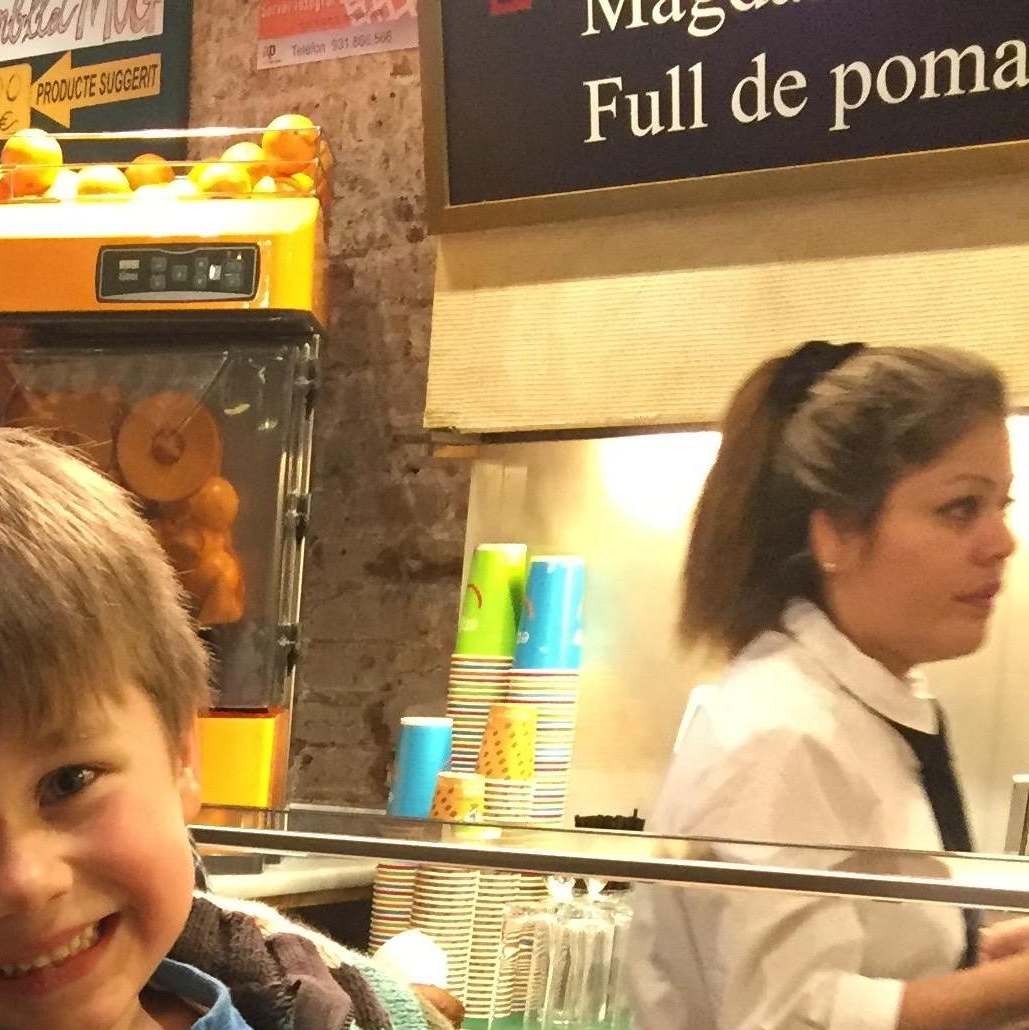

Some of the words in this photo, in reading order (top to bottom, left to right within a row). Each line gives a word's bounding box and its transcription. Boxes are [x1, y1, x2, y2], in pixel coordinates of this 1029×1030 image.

[36, 74, 97, 105] PRODUCTE
[99, 64, 158, 95] SUGGERIT
[583, 62, 708, 143] Full
[731, 52, 809, 123] de
[829, 37, 1029, 132] poma
